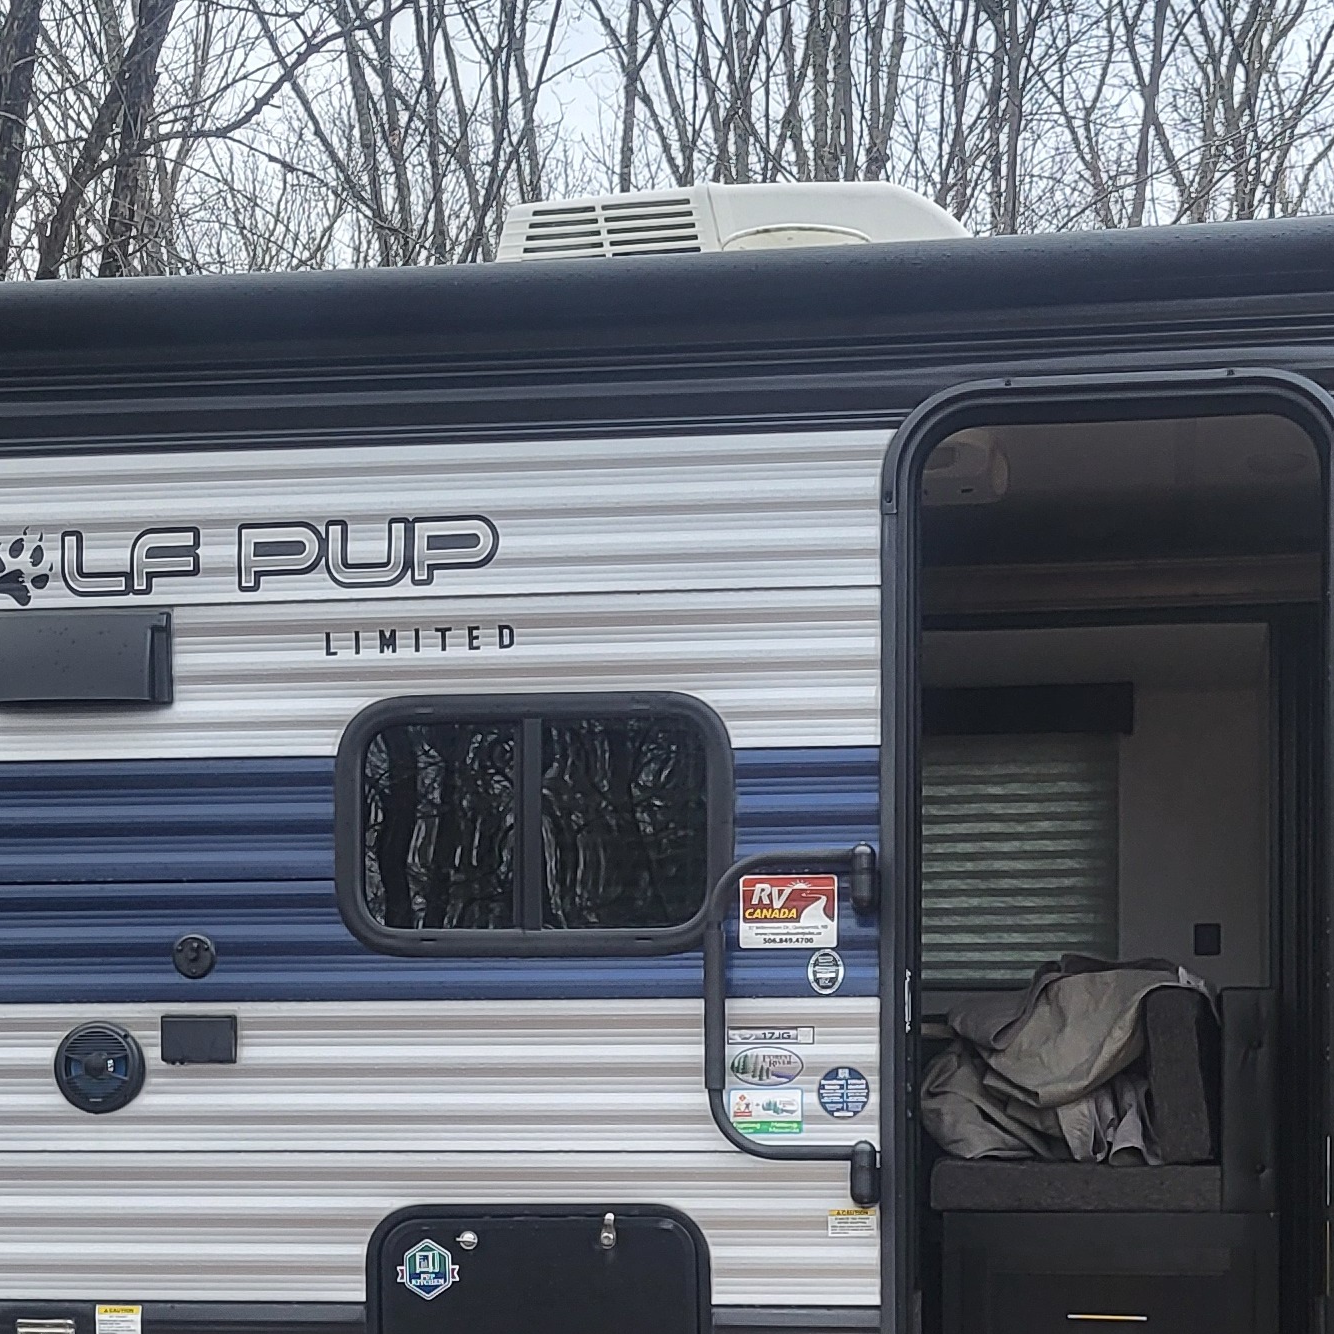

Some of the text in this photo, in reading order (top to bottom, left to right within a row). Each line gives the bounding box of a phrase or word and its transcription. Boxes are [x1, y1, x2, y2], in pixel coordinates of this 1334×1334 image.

[236, 514, 500, 592] PUP
[324, 624, 515, 656] LIMITED
[750, 883, 793, 909] RV
[745, 908, 797, 919] CANADA
[762, 937, 814, 945] 506.849.4700
[761, 1031, 792, 1040] 17JG
[768, 1060, 793, 1068] RIVER
